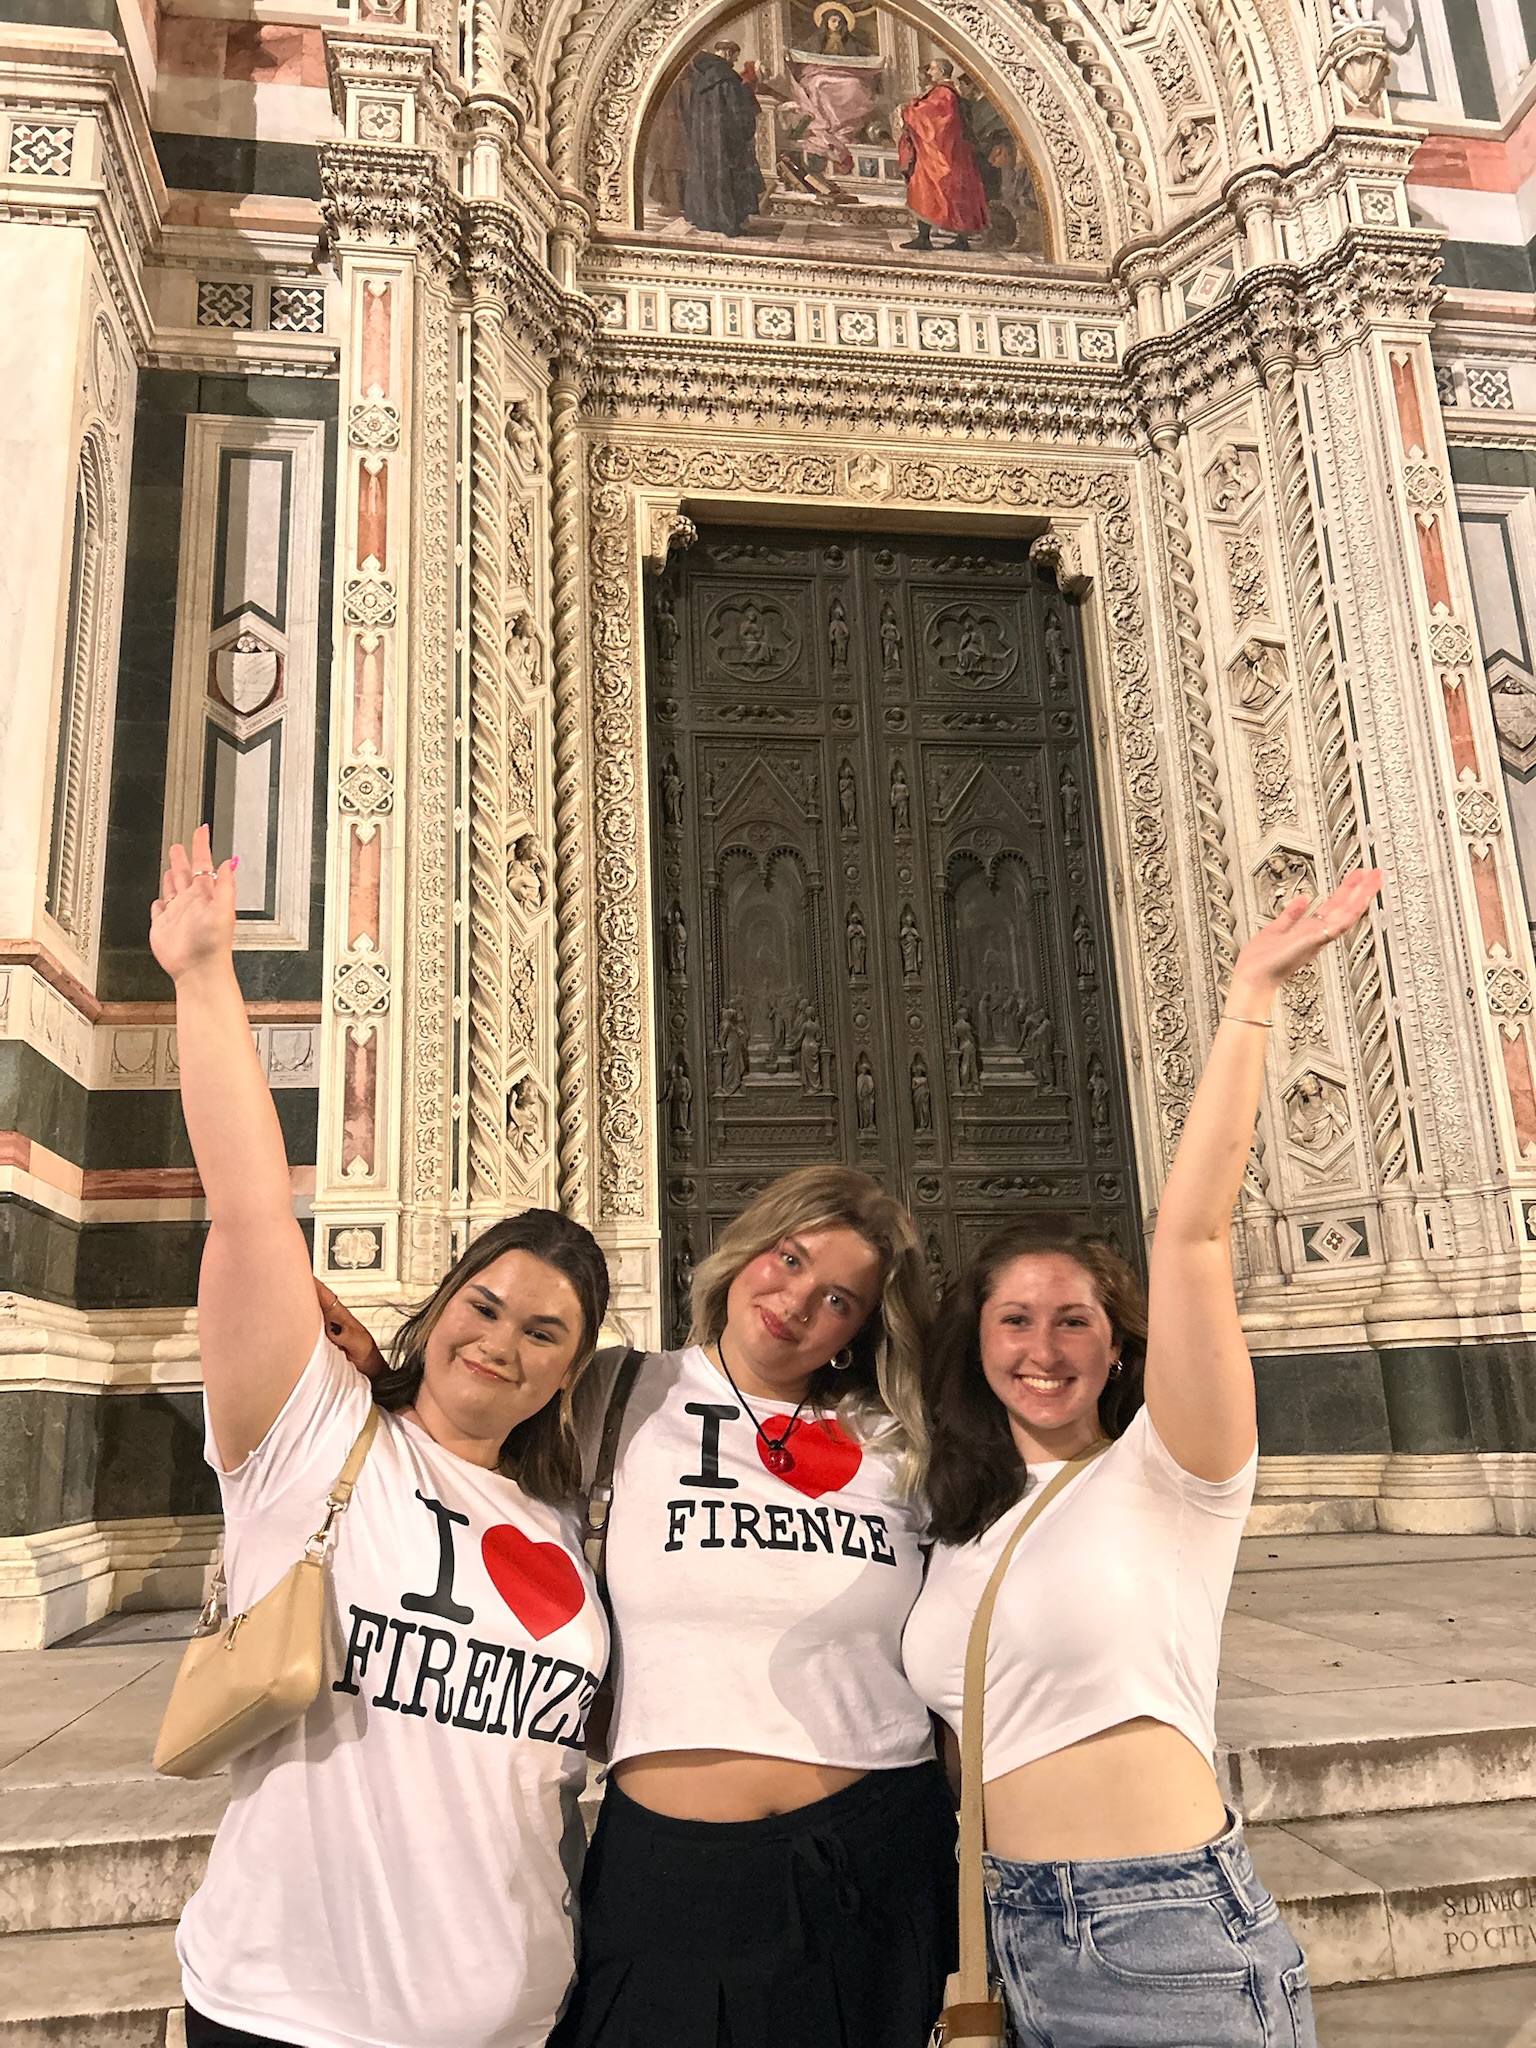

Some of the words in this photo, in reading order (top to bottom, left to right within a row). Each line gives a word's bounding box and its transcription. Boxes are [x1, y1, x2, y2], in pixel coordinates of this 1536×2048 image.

[679, 1402, 741, 1489] I
[400, 1488, 475, 1625] I
[664, 1499, 897, 1567] FIRENZE
